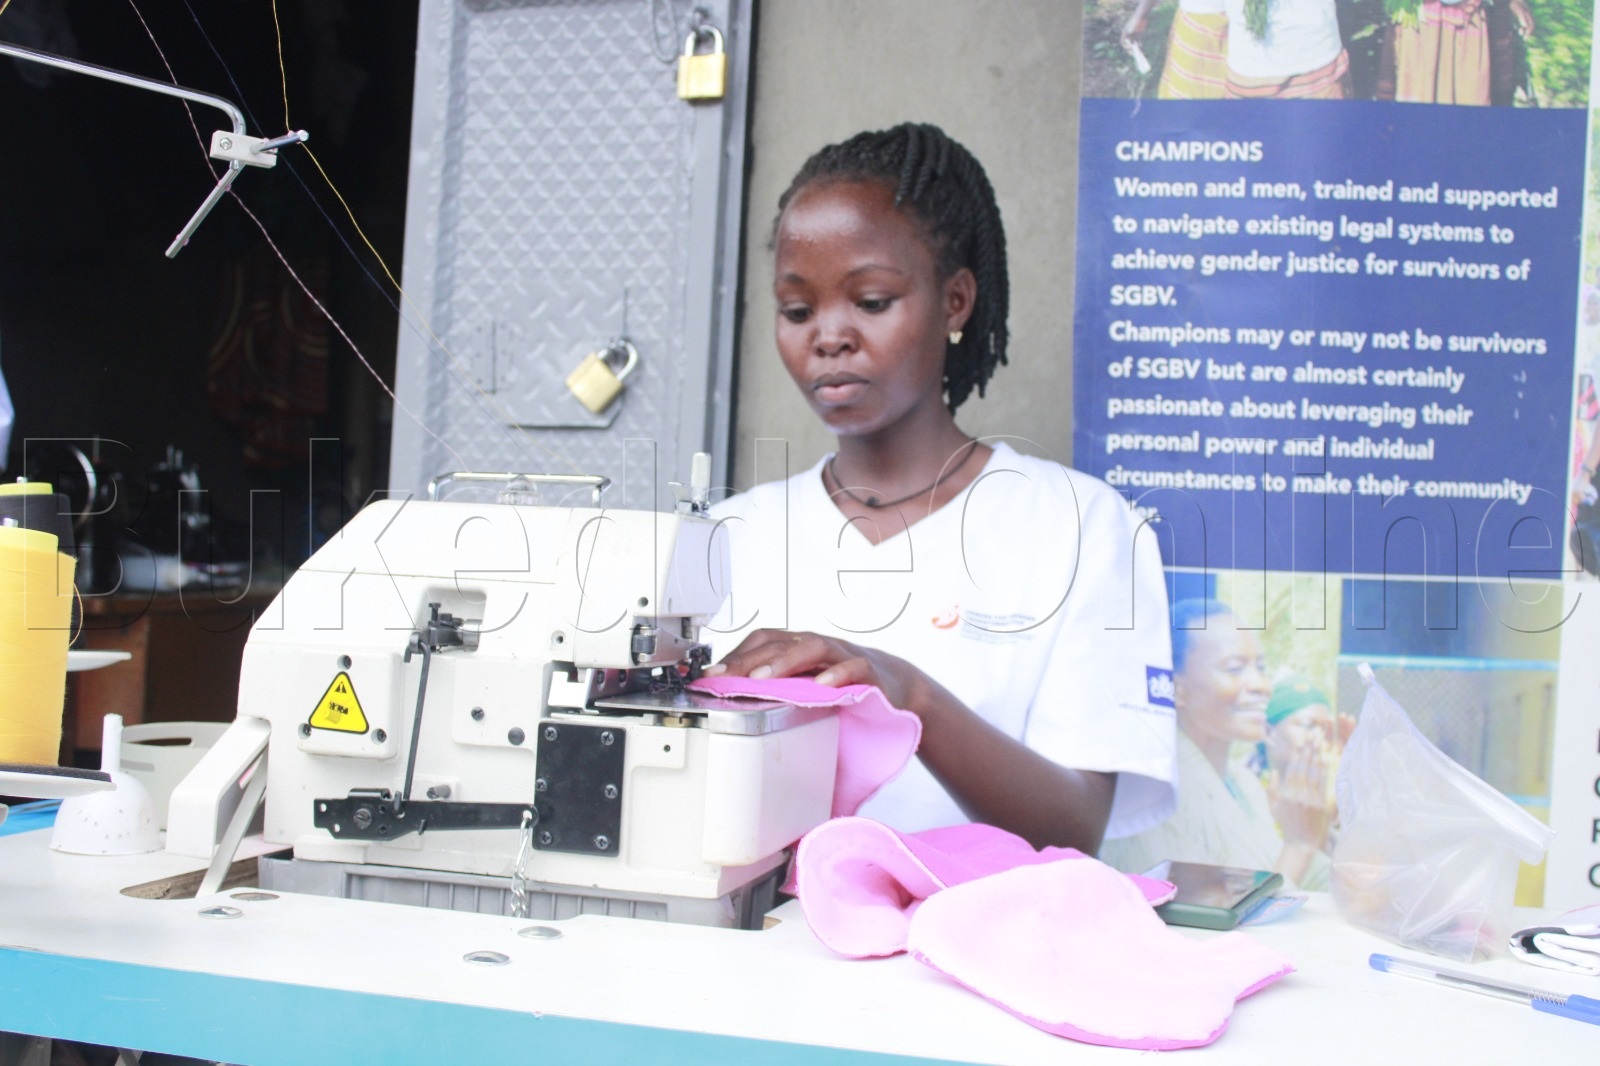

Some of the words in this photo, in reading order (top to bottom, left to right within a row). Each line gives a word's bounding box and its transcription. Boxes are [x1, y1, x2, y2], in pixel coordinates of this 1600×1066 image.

[1116, 141, 1263, 161] CHAMPIONS
[1115, 177, 1198, 197] Women
[1204, 177, 1246, 197] and
[1252, 183, 1307, 200] men,
[1313, 179, 1393, 201] trained
[1399, 182, 1439, 203] and
[1445, 186, 1558, 211] supported
[1113, 215, 1138, 233] to
[1143, 213, 1239, 239] navigate
[1245, 214, 1334, 241] existing
[1340, 215, 1393, 243] legal
[1399, 222, 1484, 245] systems
[1490, 225, 1514, 243] to
[1112, 248, 1195, 270] achieve
[1201, 250, 1282, 275] gender
[1285, 251, 1359, 277] justice
[1365, 253, 1398, 275] for
[1404, 257, 1500, 279] survivors
[1506, 259, 1531, 280] of
[1111, 285, 1177, 305] SGBV.
[1109, 320, 1231, 347] Champions
[1237, 328, 1284, 350] may
[1290, 330, 1315, 345] or
[1321, 331, 1367, 353] may
[1373, 331, 1410, 349] not
[1416, 328, 1442, 350] be
[1449, 332, 1547, 354] survivors
[1108, 356, 1133, 377] of
[1138, 358, 1201, 379] SGBV
[1207, 358, 1245, 380] but
[1251, 366, 1287, 382] are
[1293, 361, 1367, 384] almost
[1373, 366, 1465, 393] certainly
[1108, 395, 1224, 418] passionate
[1230, 396, 1296, 419] about
[1302, 398, 1416, 428] leveraging
[1422, 403, 1473, 425] their
[1107, 431, 1199, 454] personal
[1205, 437, 1278, 457] power
[1283, 435, 1325, 456] and
[1331, 436, 1434, 460] individual
[1105, 465, 1256, 491] circumstances
[1262, 473, 1286, 492] to
[1292, 472, 1352, 494] make
[1357, 473, 1408, 496] their
[1413, 479, 1533, 505] community
